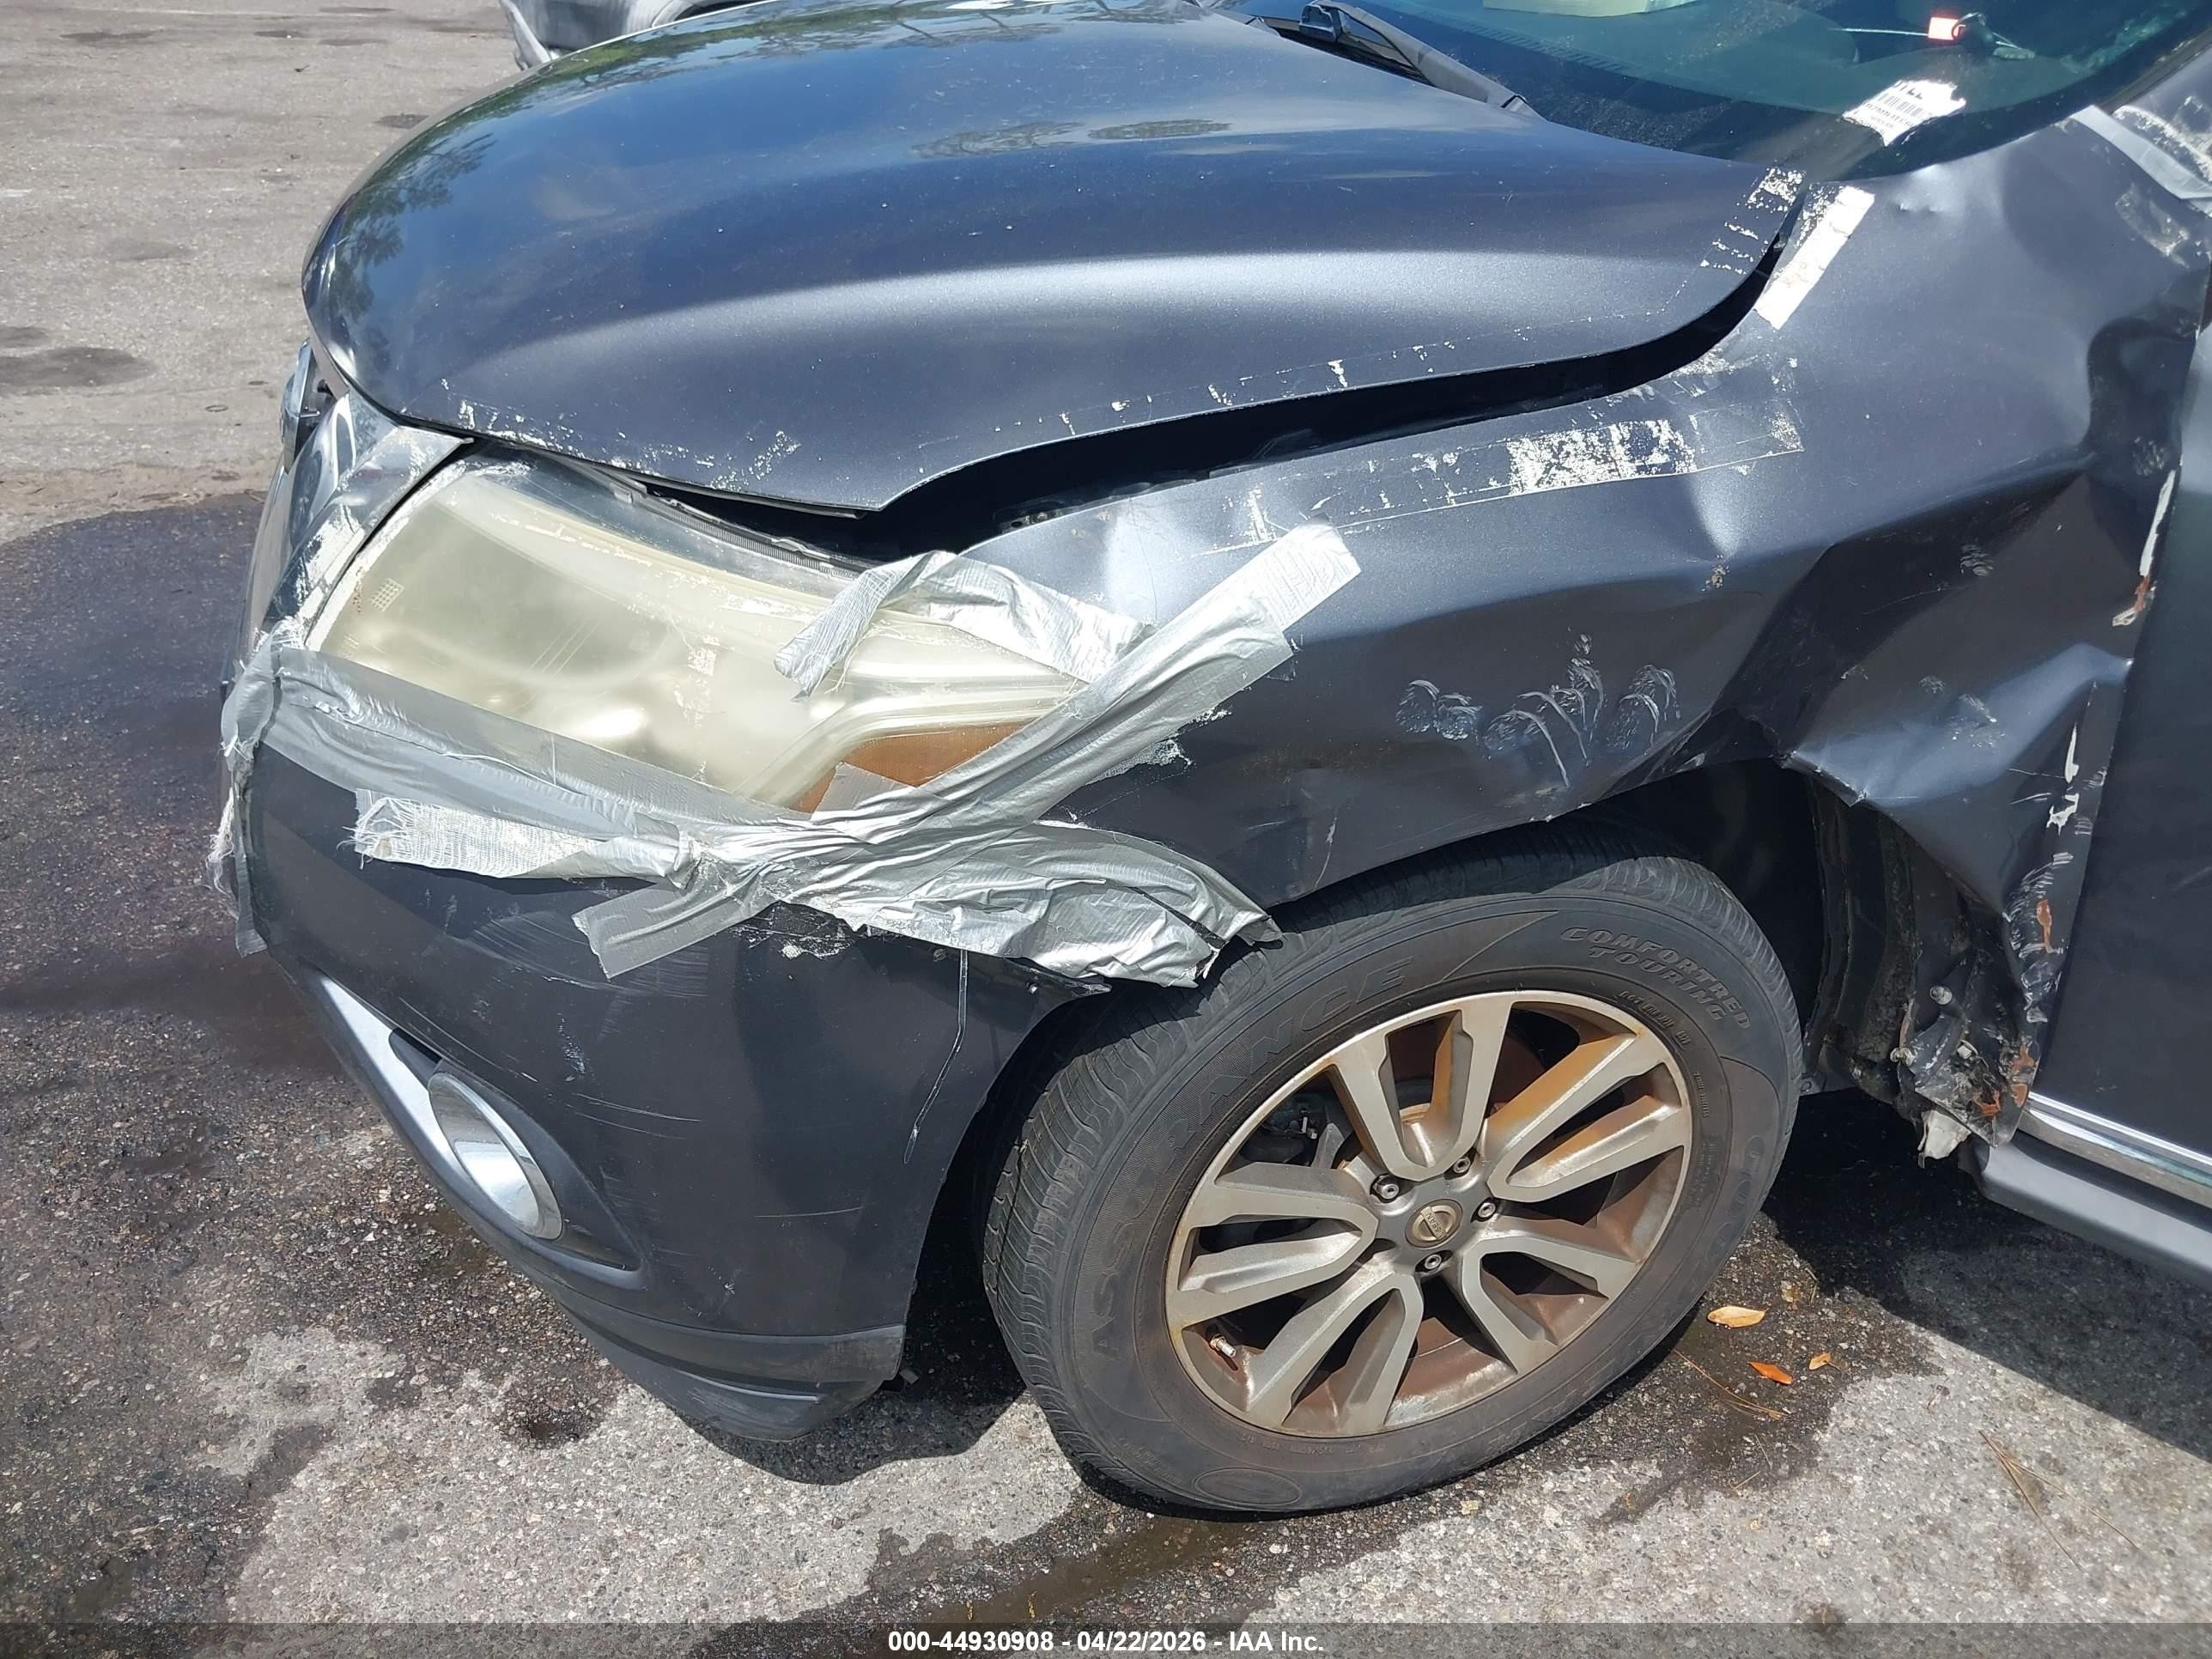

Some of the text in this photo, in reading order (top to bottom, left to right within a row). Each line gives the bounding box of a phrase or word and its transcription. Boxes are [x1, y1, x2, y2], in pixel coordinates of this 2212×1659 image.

[1560, 927, 1751, 1029] COMFORTRED
[1589, 945, 1727, 1021] TOURING
[1091, 956, 1414, 1361] ASSURANCE
